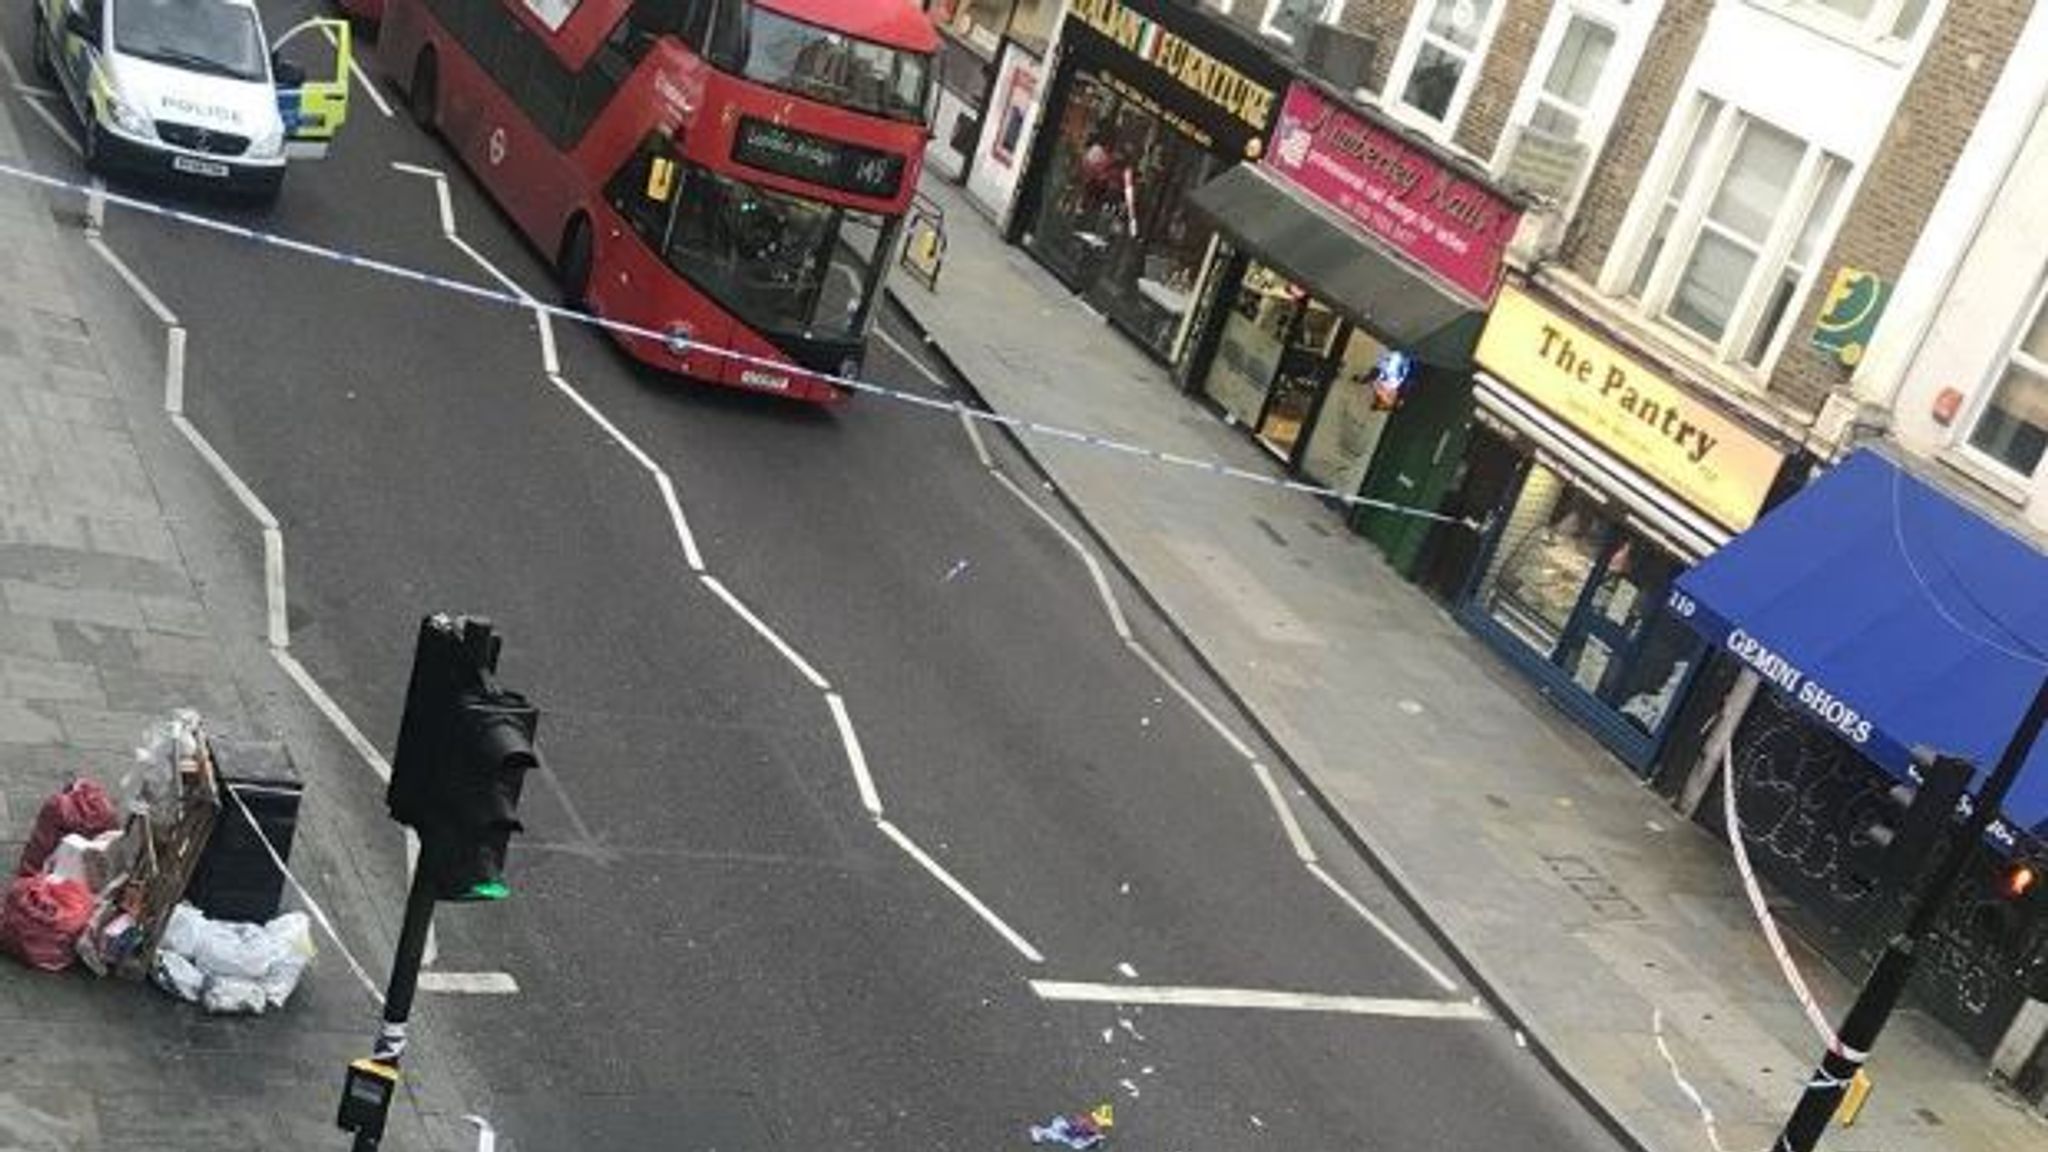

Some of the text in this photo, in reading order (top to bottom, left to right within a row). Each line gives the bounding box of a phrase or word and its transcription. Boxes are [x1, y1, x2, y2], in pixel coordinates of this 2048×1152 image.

[161, 96, 241, 125] POLICE
[1154, 32, 1275, 130] FURNITURE
[1539, 323, 1593, 383] The
[1599, 364, 1719, 463] Pantry
[1726, 627, 1874, 743] GEMINI SHOES
